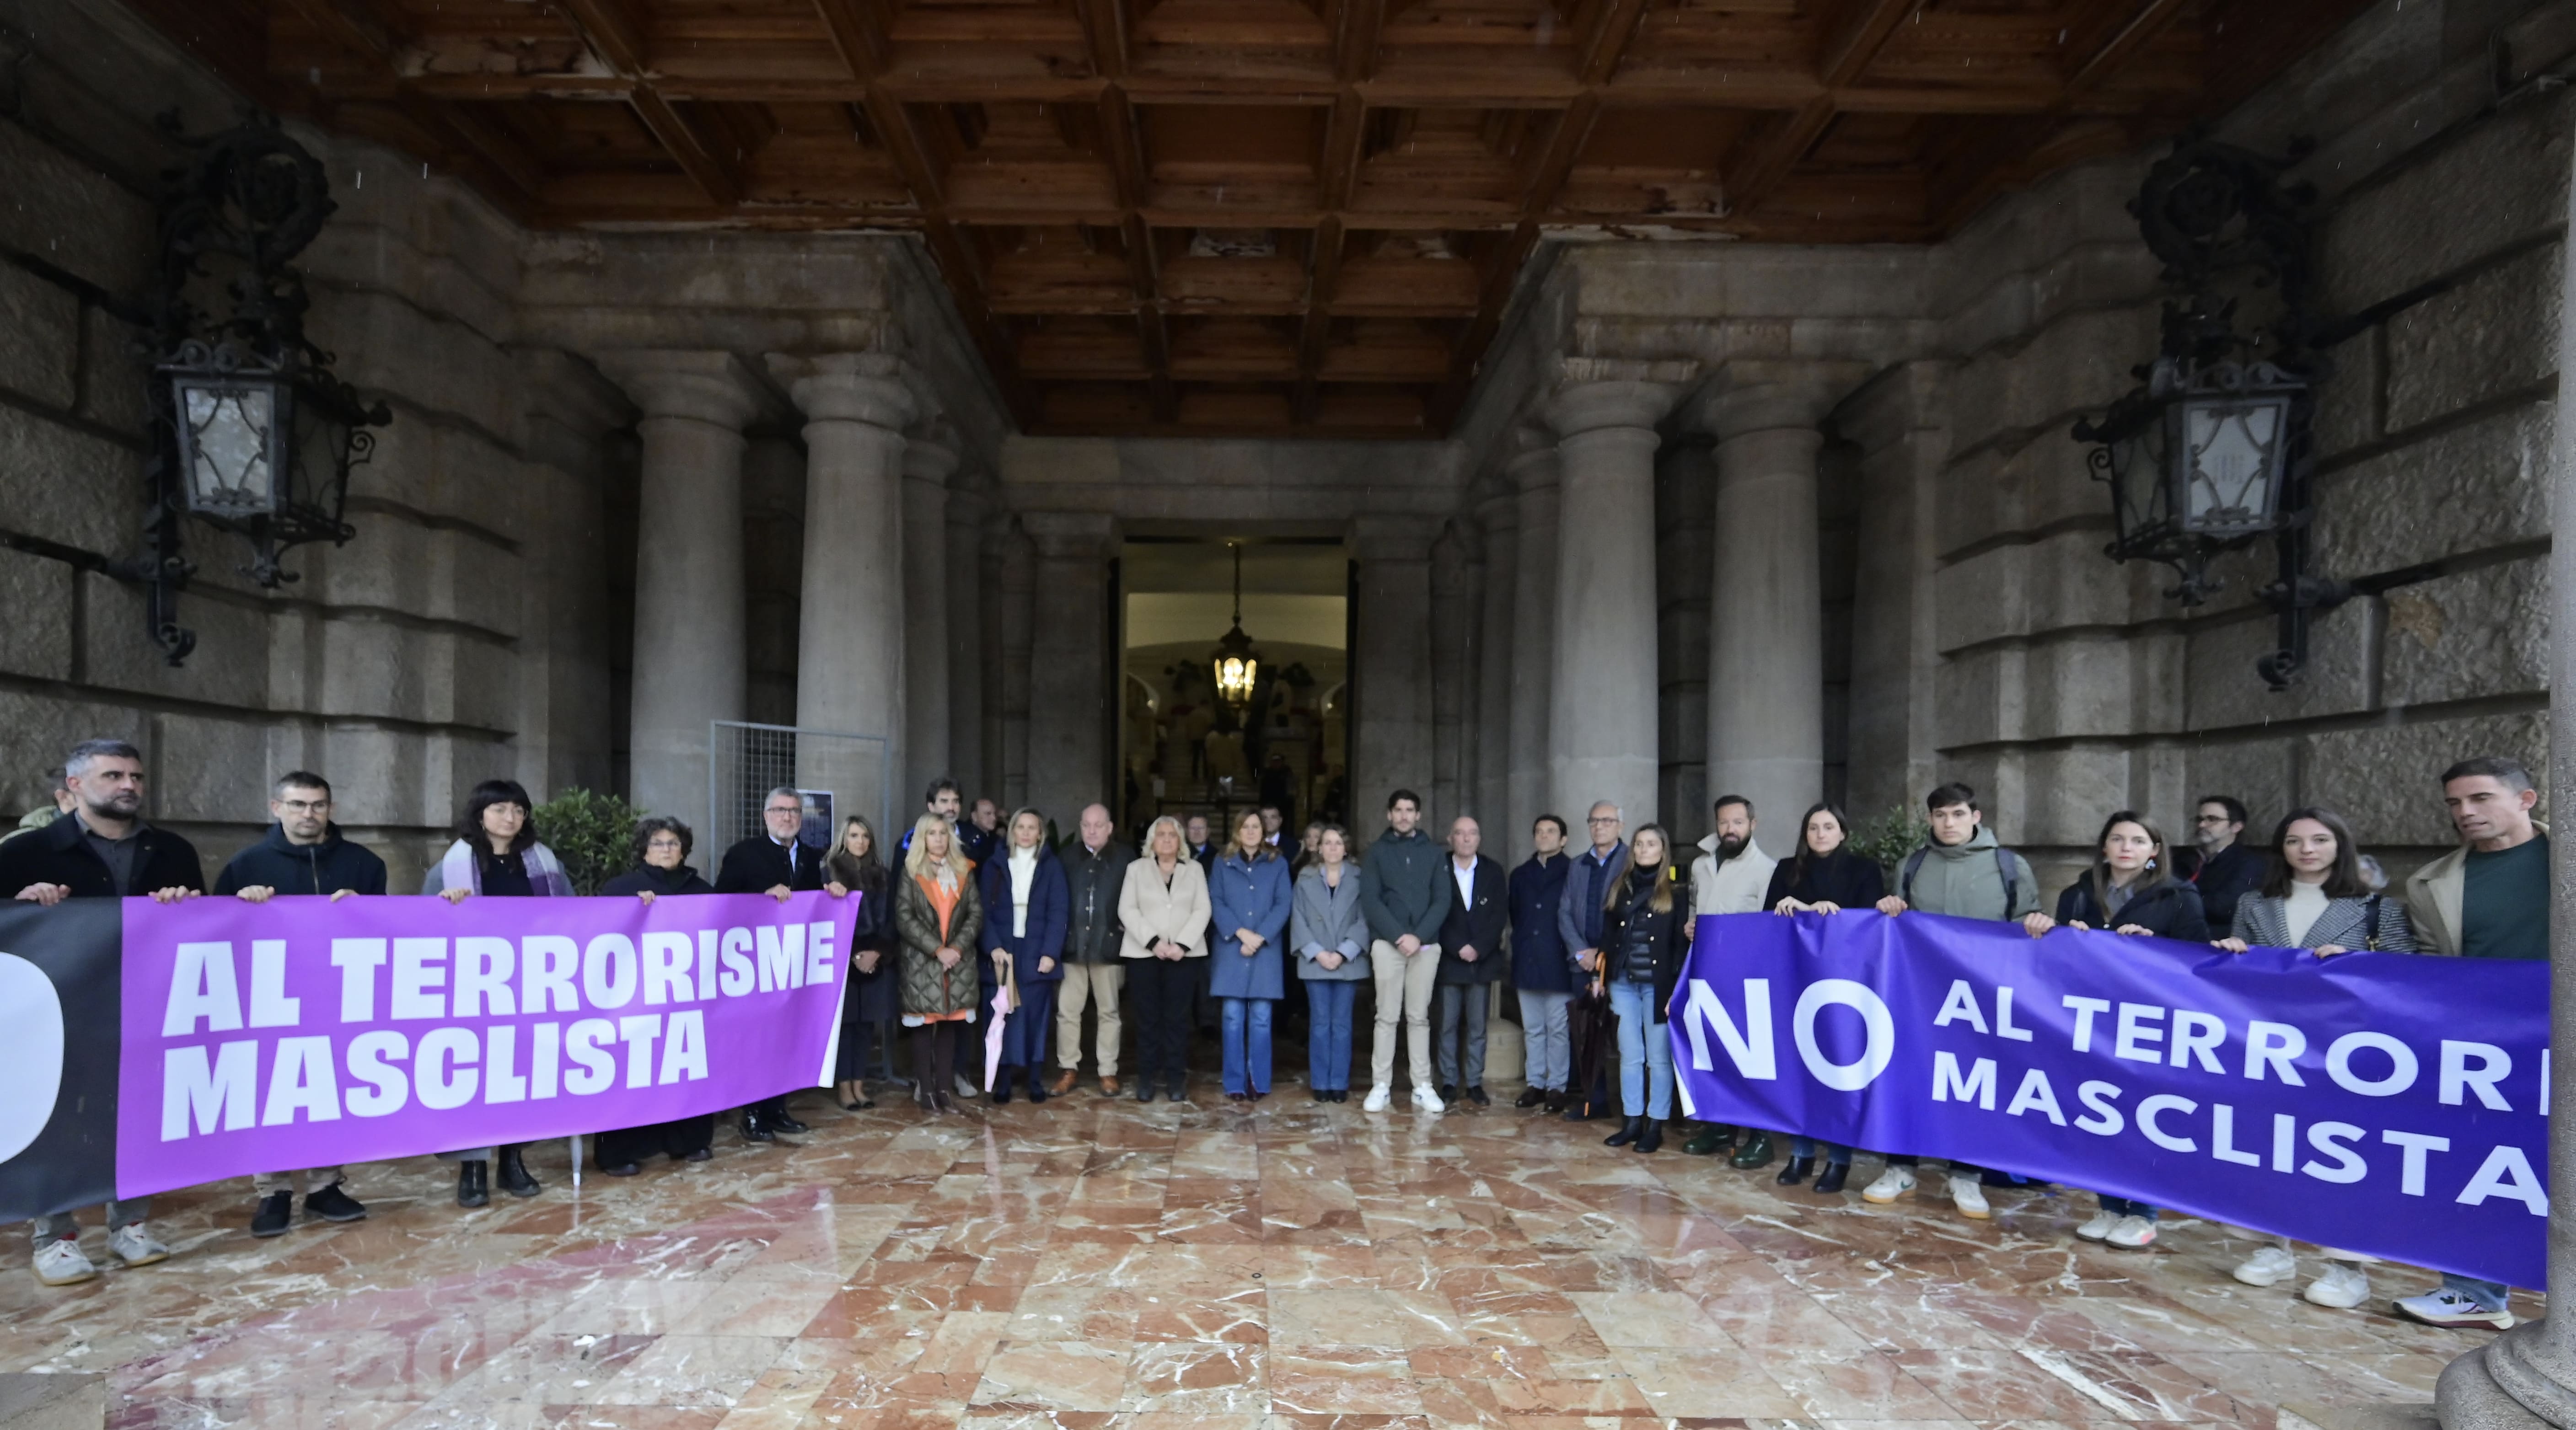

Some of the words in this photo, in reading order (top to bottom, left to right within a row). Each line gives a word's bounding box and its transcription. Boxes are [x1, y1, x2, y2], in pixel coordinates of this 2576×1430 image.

[161, 940, 301, 1037] AL
[330, 920, 836, 1024] TERRORISME
[1683, 978, 1895, 1092] NO
[1933, 979, 2033, 1042] AL
[160, 1009, 709, 1142] MASCLISTA
[1931, 1050, 2549, 1217] MASCLISTA
